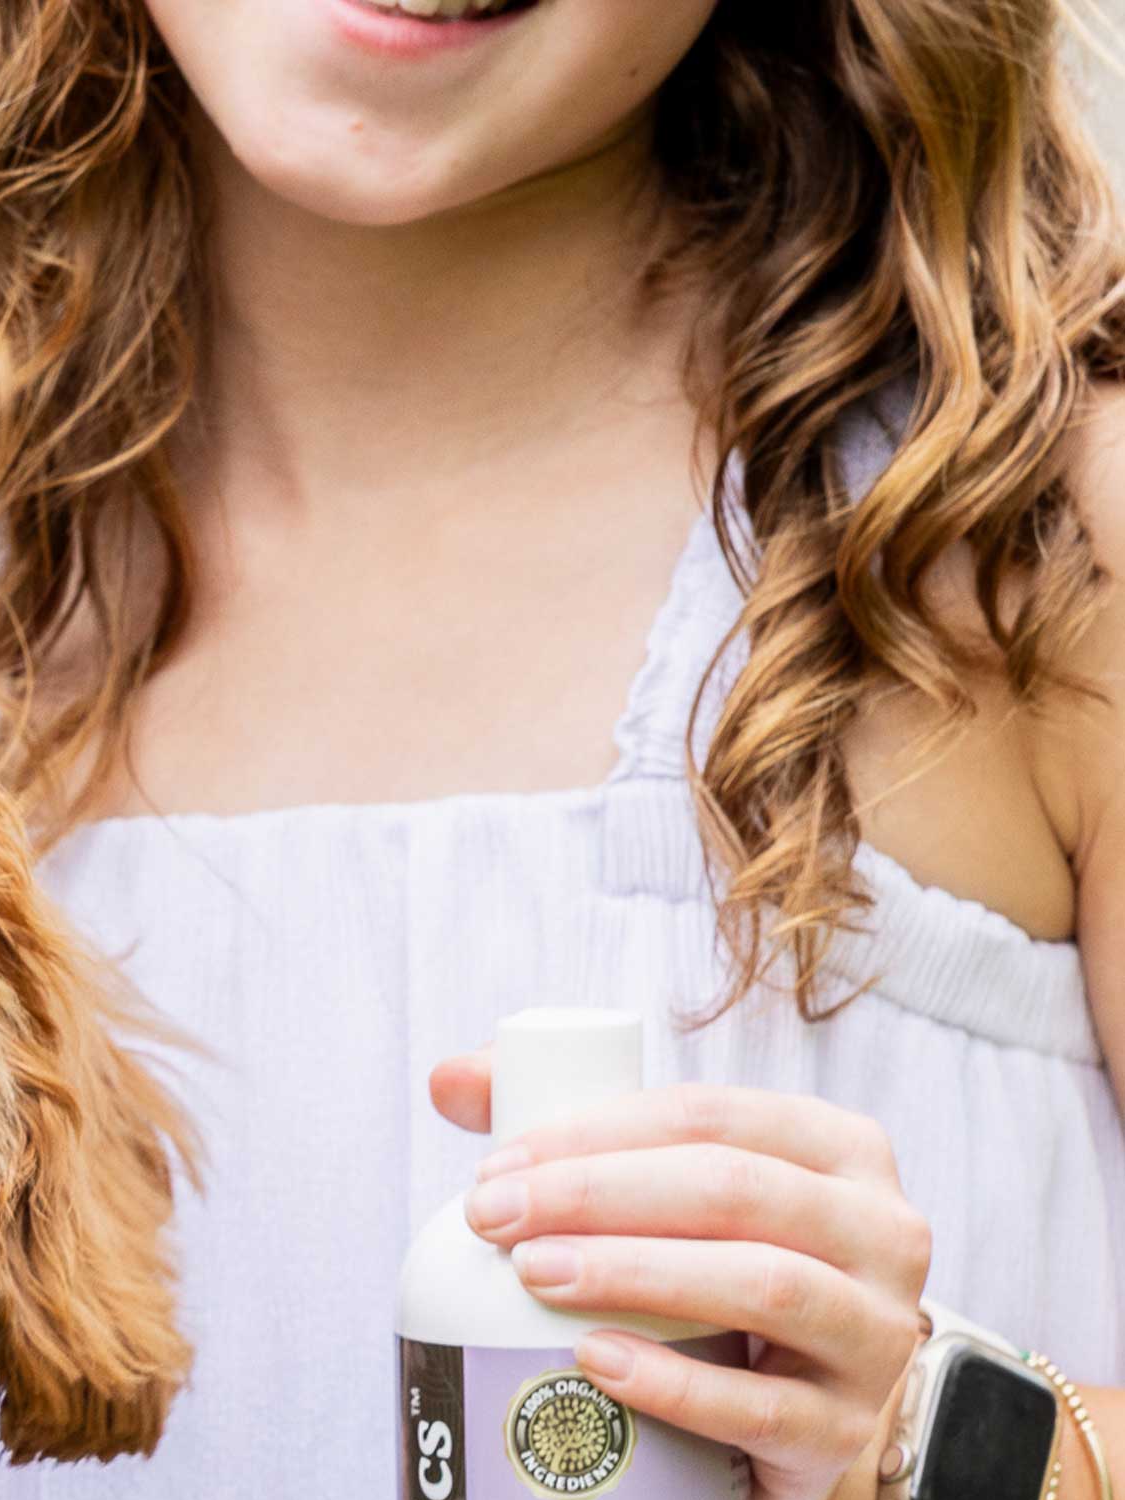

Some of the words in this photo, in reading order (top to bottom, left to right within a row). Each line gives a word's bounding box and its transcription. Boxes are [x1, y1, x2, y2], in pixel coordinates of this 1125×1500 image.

[520, 1384, 556, 1420] 100%
[555, 1379, 619, 1419] ORGANIC
[520, 1450, 620, 1491] INGREDIENTS
